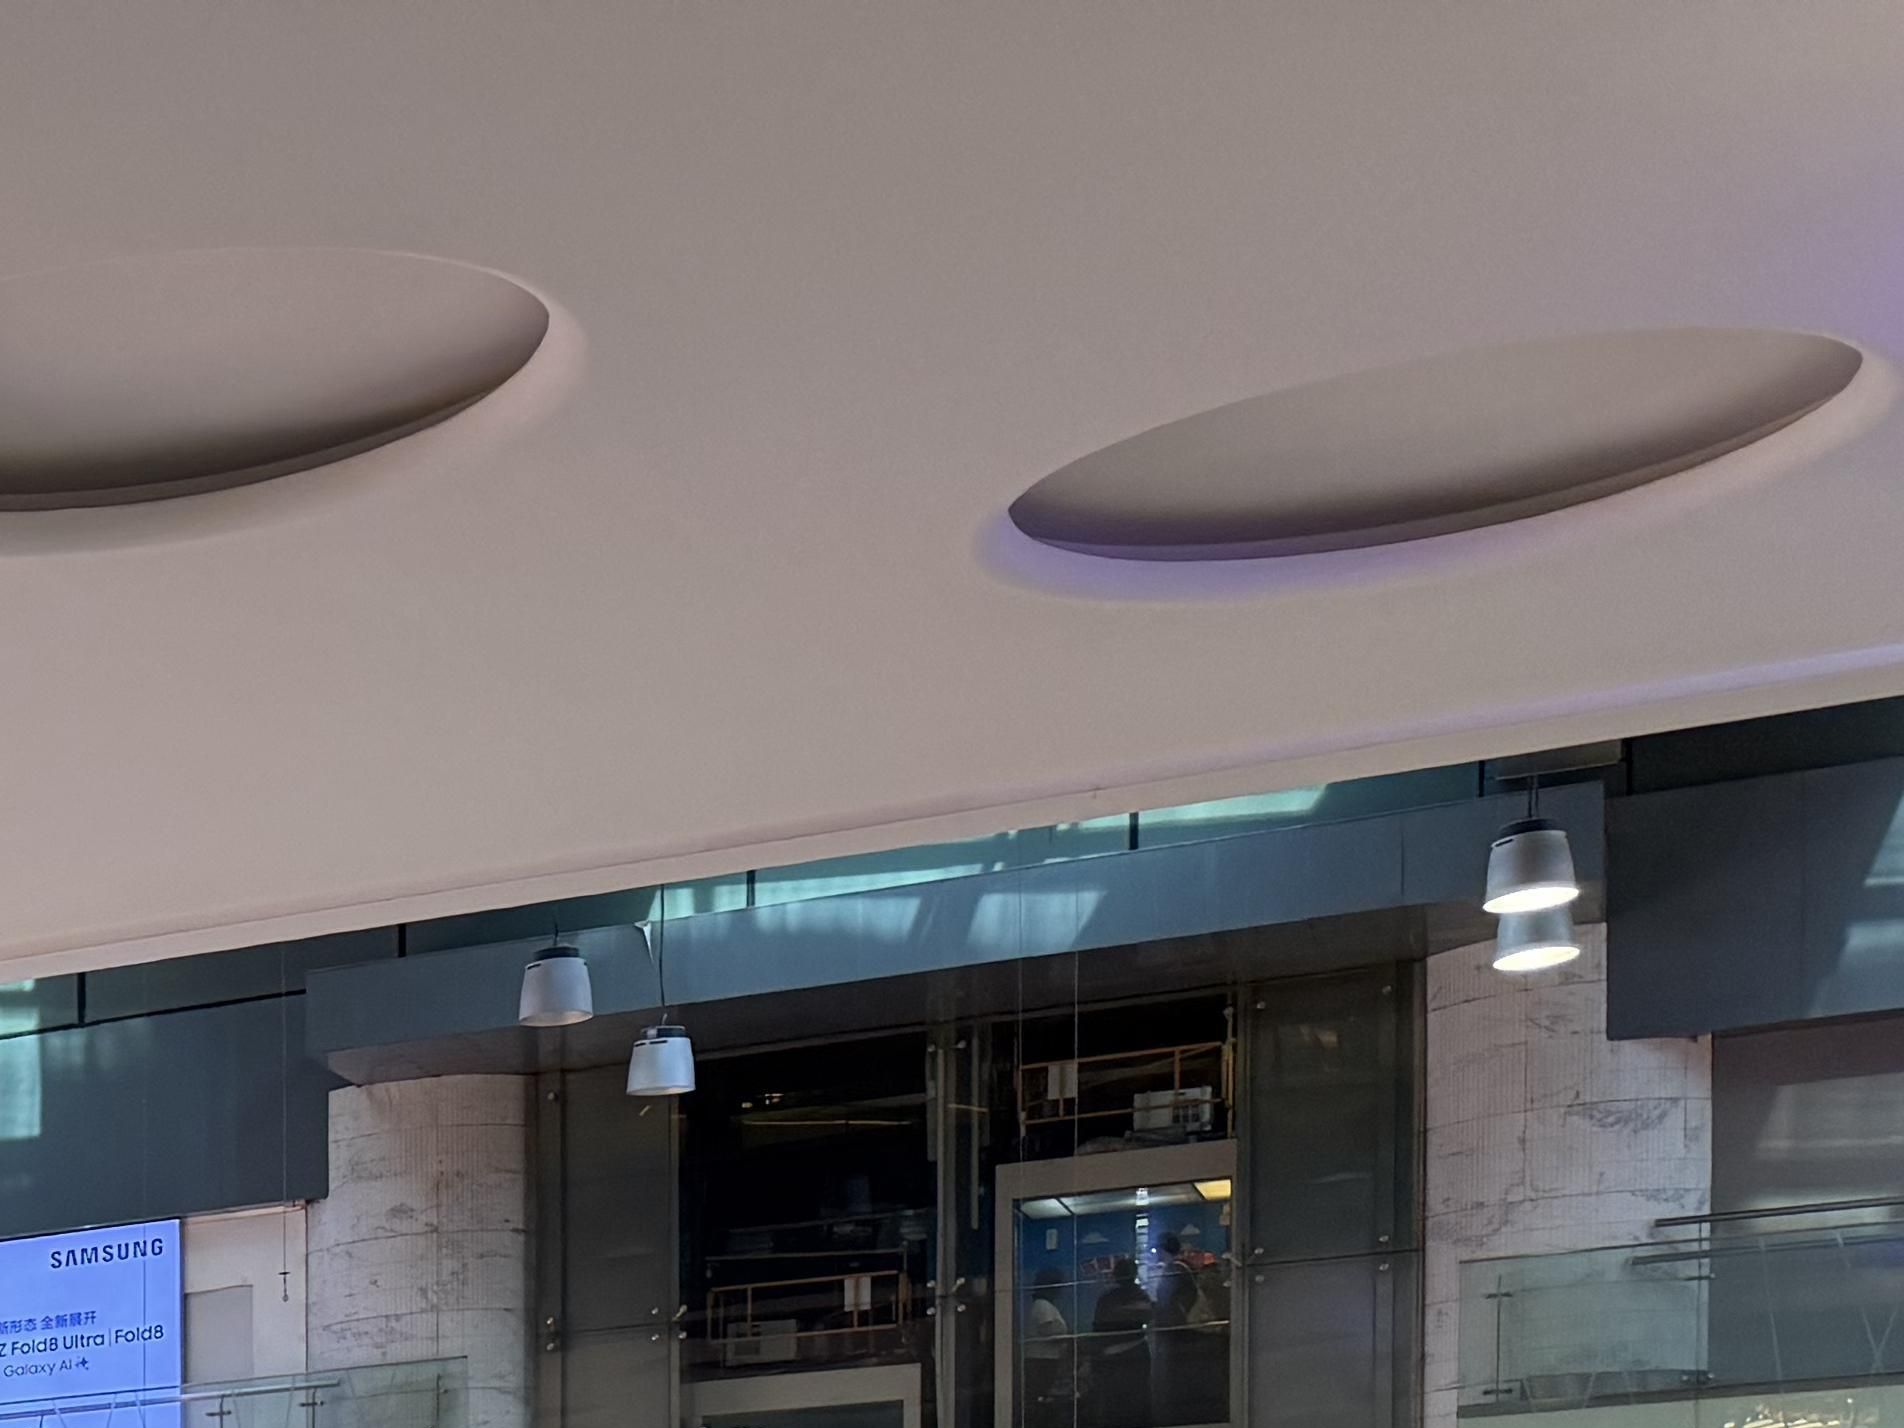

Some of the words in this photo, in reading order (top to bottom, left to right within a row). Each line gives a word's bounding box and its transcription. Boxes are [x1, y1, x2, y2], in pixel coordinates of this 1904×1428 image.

[51, 1238, 164, 1269] SAMSUNG
[40, 1310, 97, 1330] 全新展开
[11, 1337, 58, 1356] Fold8
[63, 1332, 105, 1350] Ultra
[115, 1324, 165, 1344] Fold8
[3, 1361, 56, 1377] Galaxy
[59, 1359, 73, 1371] AI
